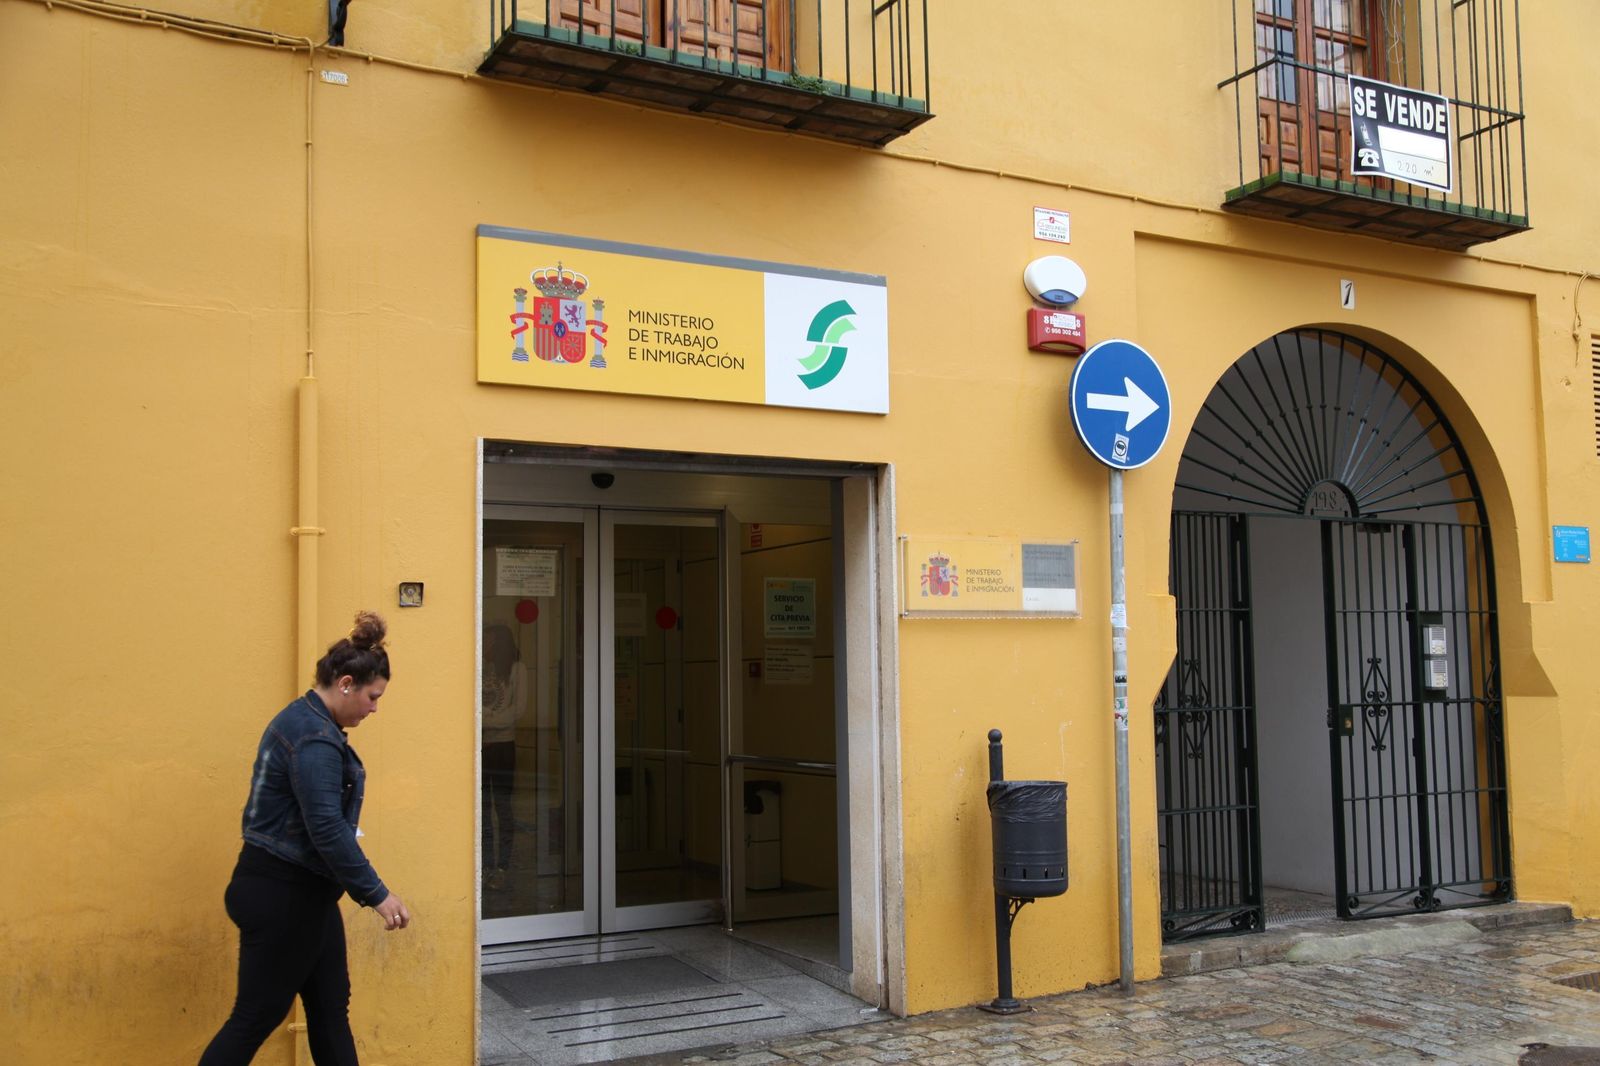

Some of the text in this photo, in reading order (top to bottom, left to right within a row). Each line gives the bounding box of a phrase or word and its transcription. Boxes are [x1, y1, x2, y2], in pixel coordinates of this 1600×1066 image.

[1353, 86, 1447, 134] SE VENDE
[1343, 282, 1353, 306] 1
[628, 309, 714, 331] MINISTERIO
[628, 328, 719, 352] DE TRABAJO
[628, 346, 745, 370] E INMIGRACIÓN
[966, 568, 1001, 576] MINISTERIO
[966, 576, 1003, 586] DE TRABAJO
[972, 584, 1015, 593] INMIGRACIÓN
[774, 594, 805, 602] SERVICIO
[784, 604, 793, 612] DE
[770, 614, 810, 622] CITA PREVIA
